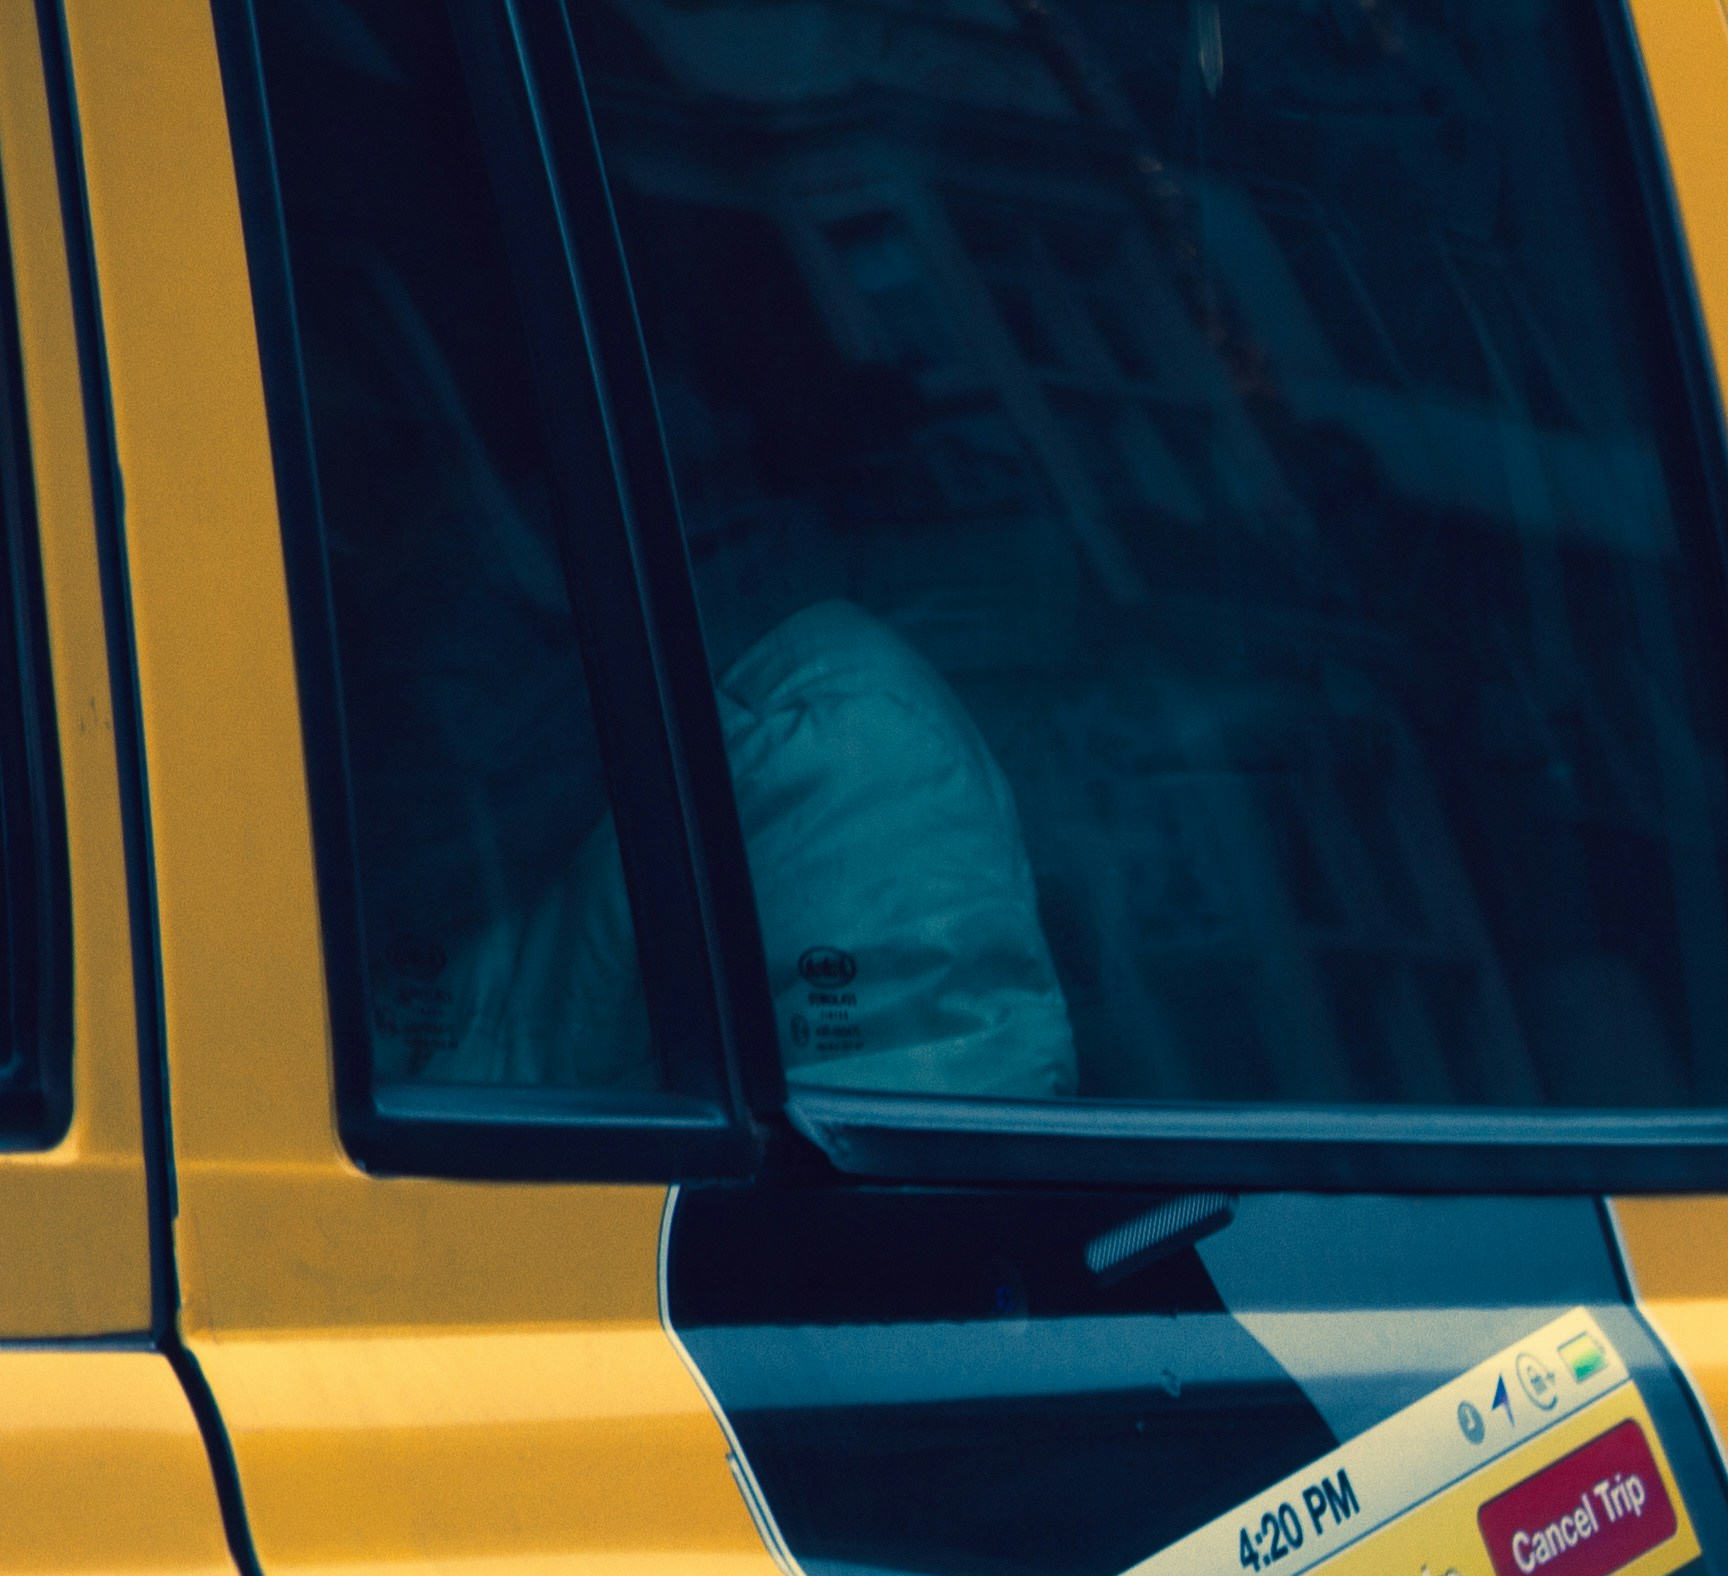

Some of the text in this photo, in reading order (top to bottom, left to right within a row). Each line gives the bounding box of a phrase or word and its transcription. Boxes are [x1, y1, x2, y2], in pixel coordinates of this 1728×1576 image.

[1238, 1470, 1359, 1572] 4:20 PM
[1512, 1471, 1646, 1574] Cancel Trip
